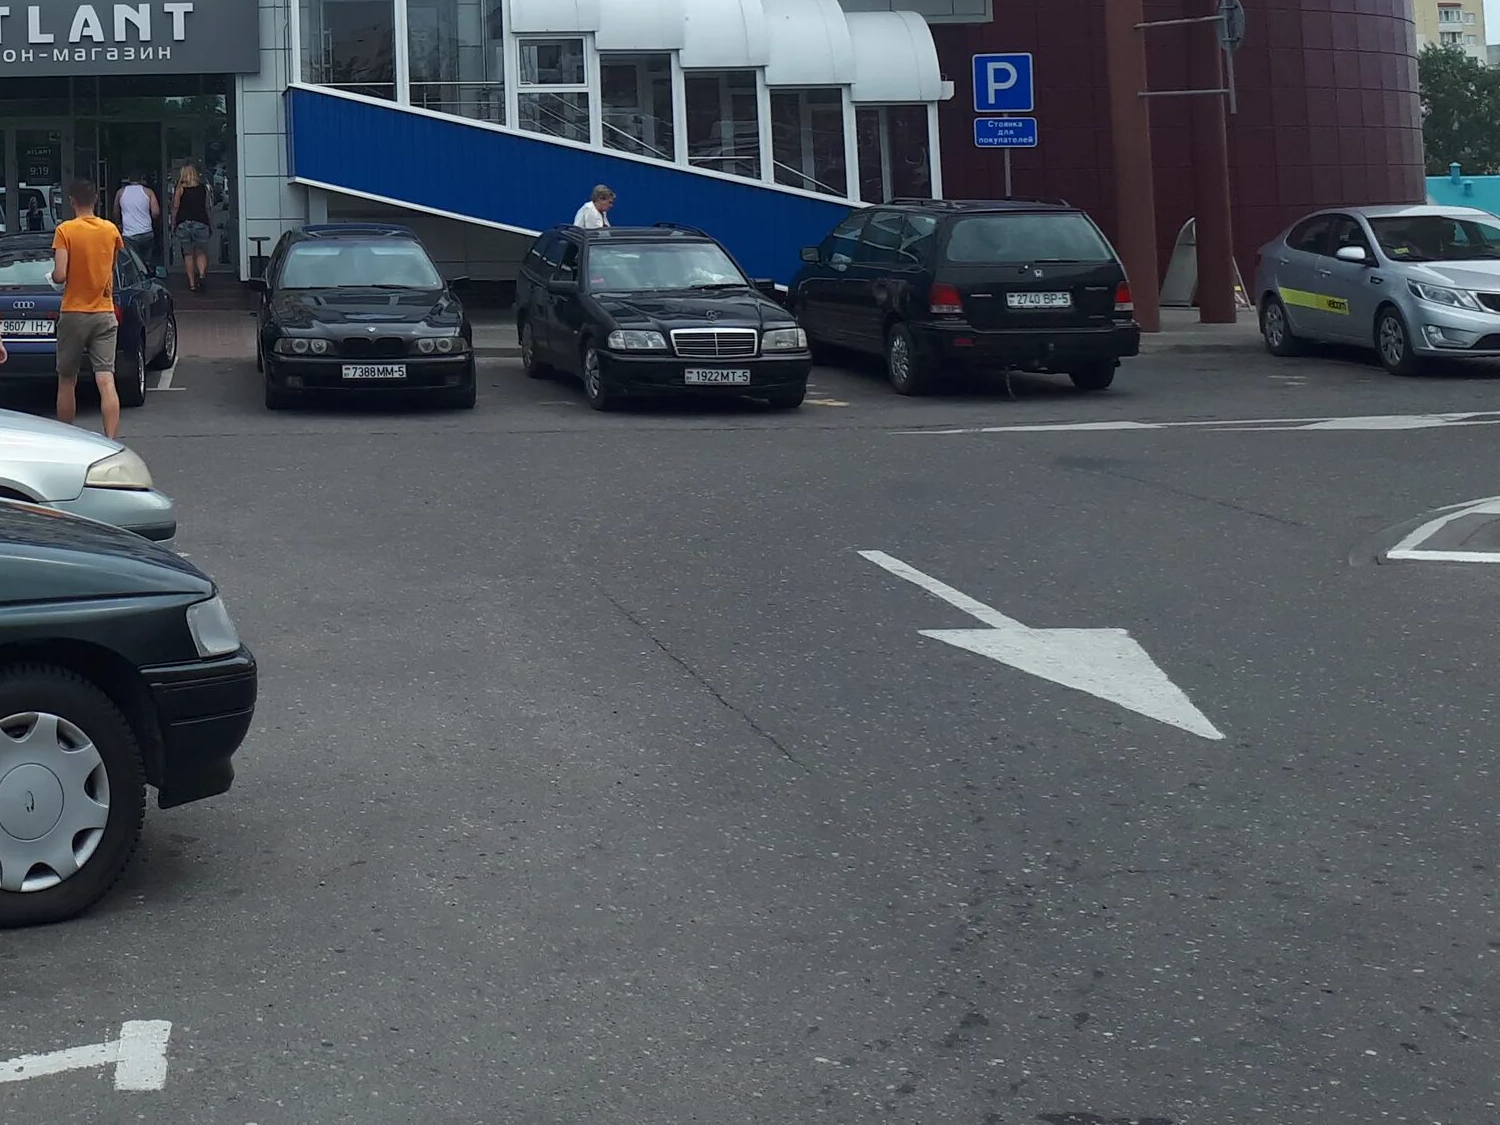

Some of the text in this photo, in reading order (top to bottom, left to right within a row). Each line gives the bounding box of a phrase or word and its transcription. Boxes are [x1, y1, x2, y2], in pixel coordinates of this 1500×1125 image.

[987, 62, 1017, 104] P
[978, 136, 1034, 144] покупателей
[3, 321, 26, 331] 9607
